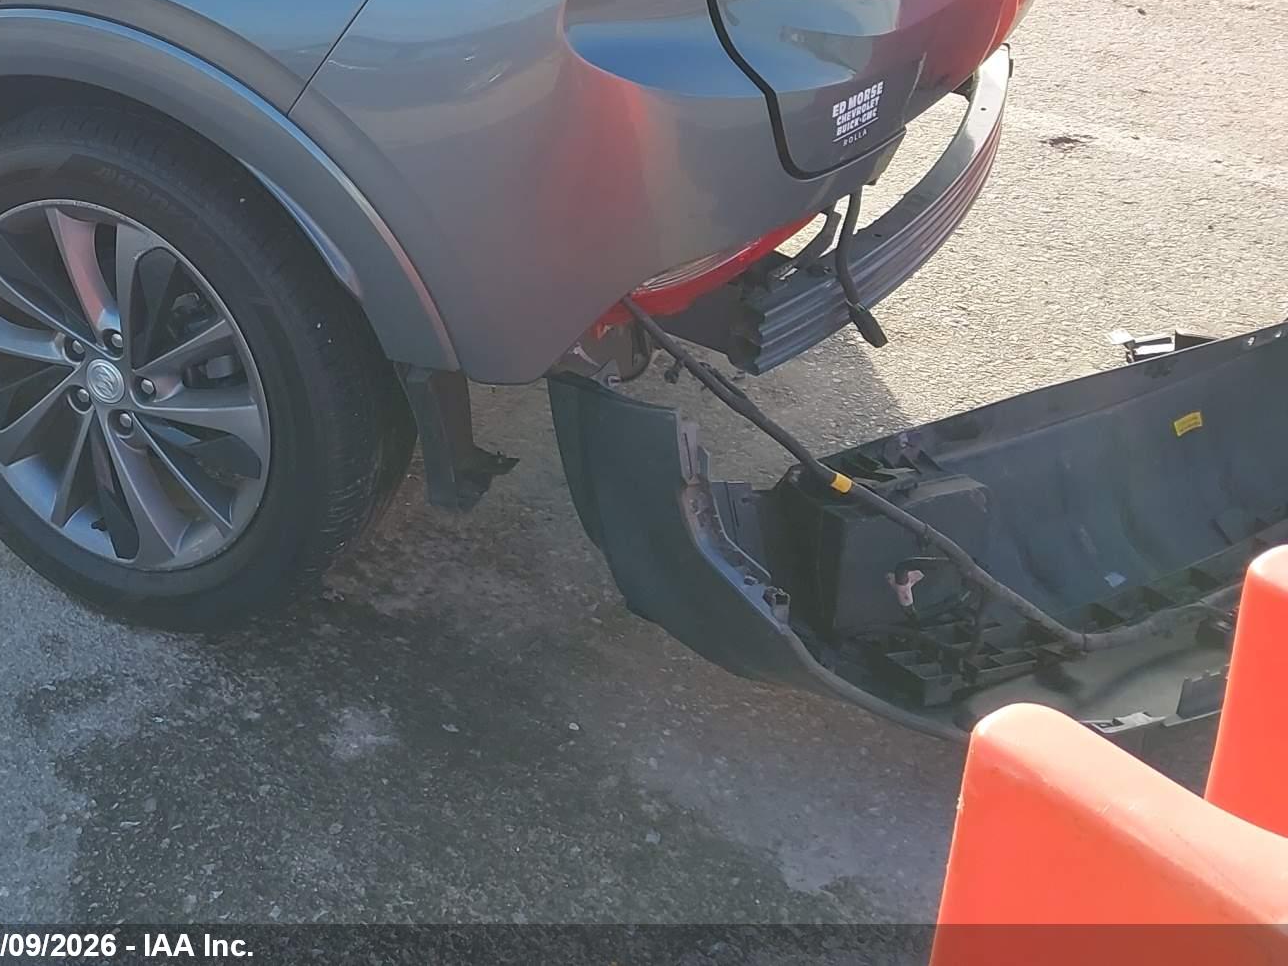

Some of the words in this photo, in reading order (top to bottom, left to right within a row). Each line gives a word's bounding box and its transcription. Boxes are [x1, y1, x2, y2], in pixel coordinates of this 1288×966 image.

[832, 101, 847, 118] ED
[848, 81, 884, 110] MORSE
[836, 95, 880, 126] CHEVROLET
[843, 128, 867, 146] ROLLA
